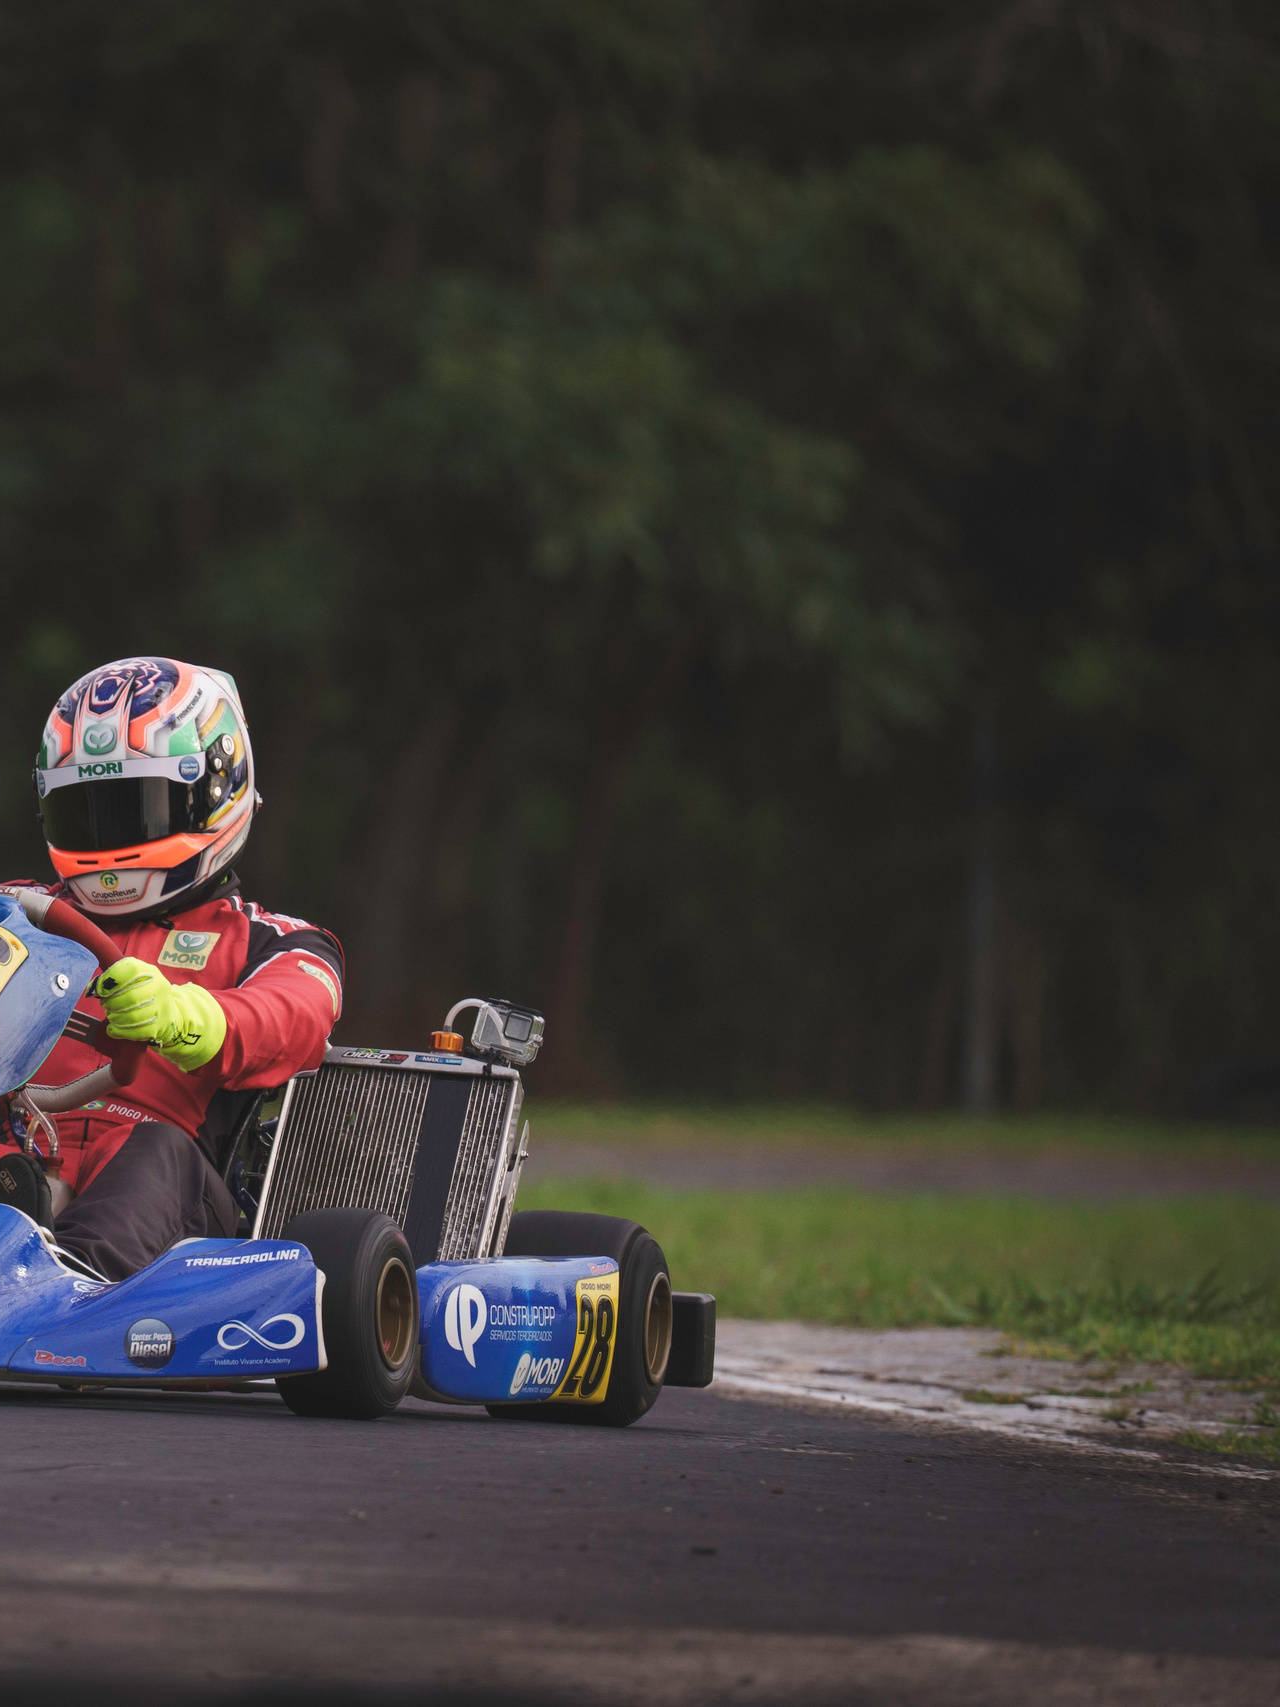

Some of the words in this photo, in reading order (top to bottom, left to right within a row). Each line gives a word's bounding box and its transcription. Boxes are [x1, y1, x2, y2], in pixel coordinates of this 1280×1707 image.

[78, 761, 122, 778] MORI
[91, 887, 137, 899] GrupoReuse
[162, 950, 206, 966] MORI
[106, 1104, 142, 1120] DIOGO
[0, 1170, 16, 1191] OMP
[185, 1249, 300, 1268] TRANSCAROLINA
[581, 1283, 596, 1291] DIOGO
[596, 1283, 612, 1291] MORI
[490, 1304, 556, 1327] CONSTRUPOPP
[131, 1333, 152, 1342] Center
[153, 1332, 172, 1343] Peças
[559, 1294, 616, 1398] 28
[130, 1341, 171, 1358] Diesel
[214, 1358, 239, 1366] Instituto
[240, 1357, 264, 1365] Vivance
[264, 1356, 292, 1365] Academy
[524, 1357, 565, 1385] MORI
